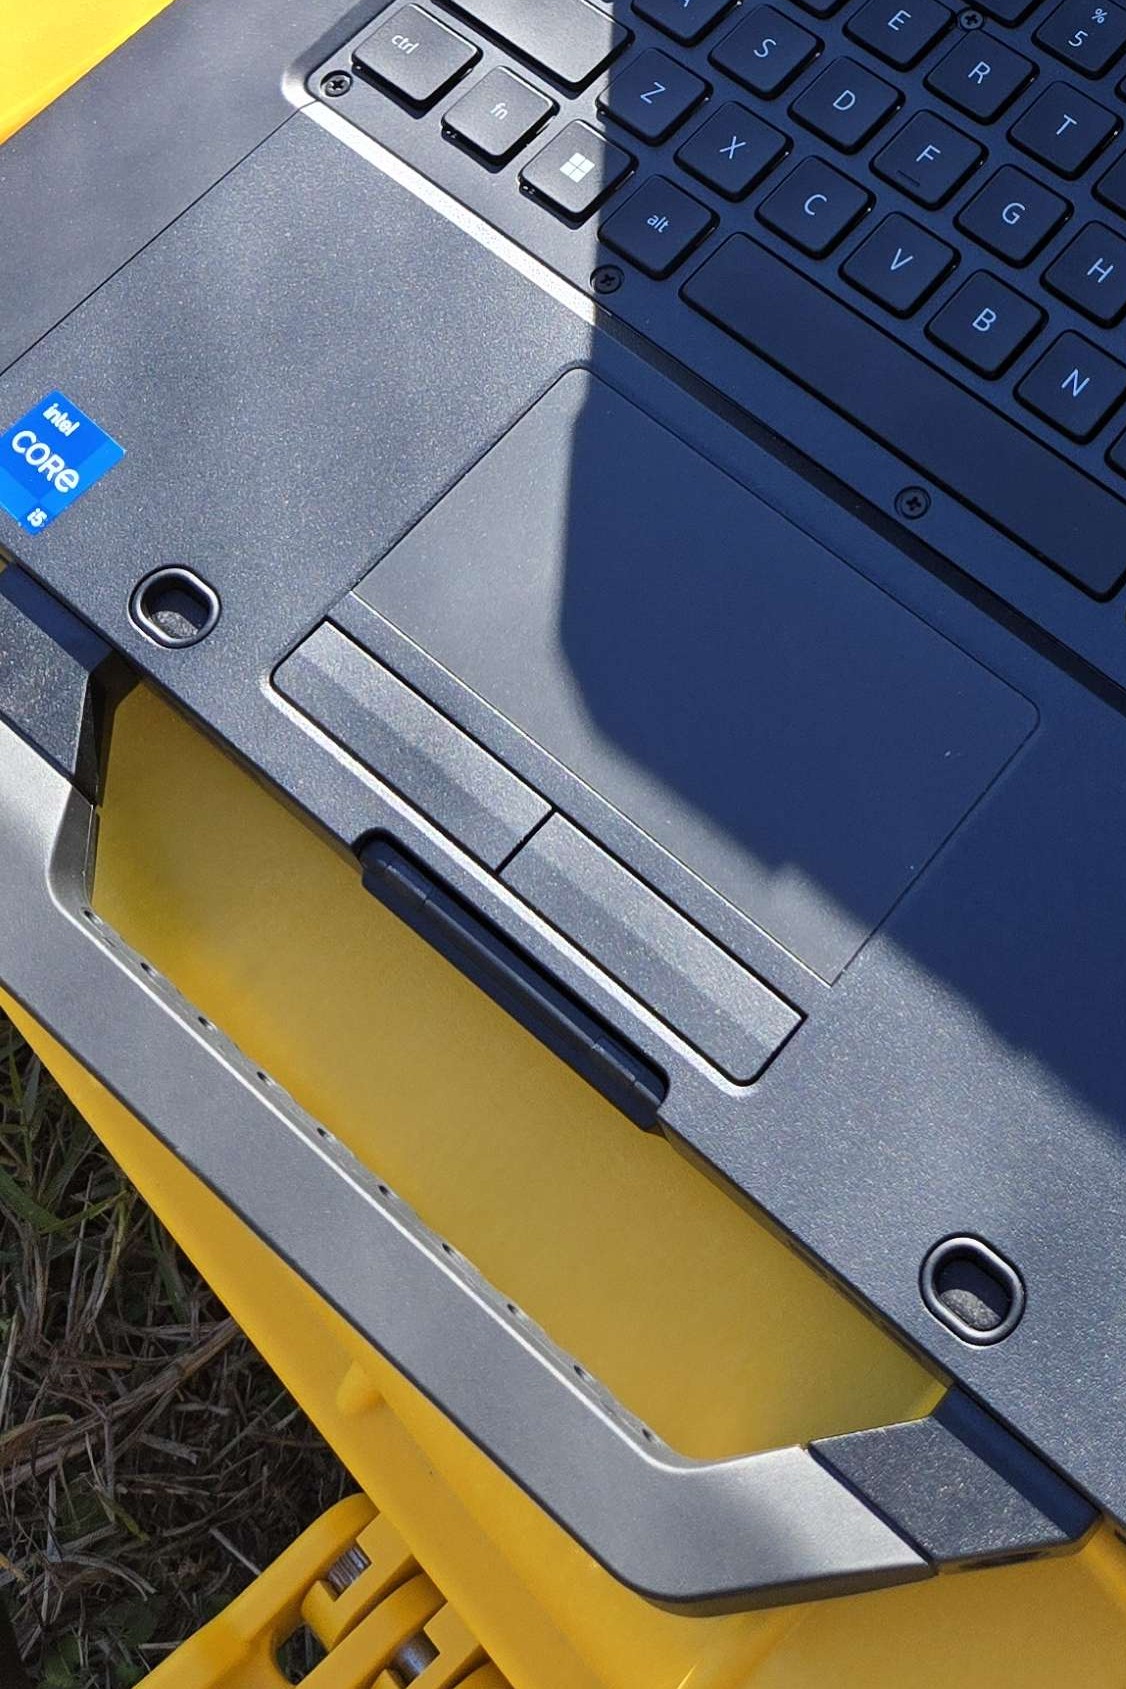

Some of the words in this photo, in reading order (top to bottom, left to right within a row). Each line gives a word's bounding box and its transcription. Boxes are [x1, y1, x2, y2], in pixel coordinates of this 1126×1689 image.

[887, 9, 912, 31] E
[1091, 8, 1108, 24] %
[391, 34, 420, 55] ctrl
[753, 38, 777, 58] S
[1068, 30, 1089, 47] 5
[967, 61, 991, 84] R
[640, 81, 666, 104] Z
[832, 89, 856, 111] D
[490, 102, 508, 120] fn
[1056, 114, 1078, 135] T
[719, 135, 747, 160] X
[916, 144, 941, 162] F
[804, 193, 828, 216] C
[1002, 202, 1026, 225] G
[647, 214, 669, 233] alt
[890, 248, 914, 271] V
[1087, 257, 1114, 283] H
[972, 307, 997, 332] B
[1061, 368, 1090, 397] N
[42, 403, 81, 437] intel
[27, 508, 48, 528] i5
